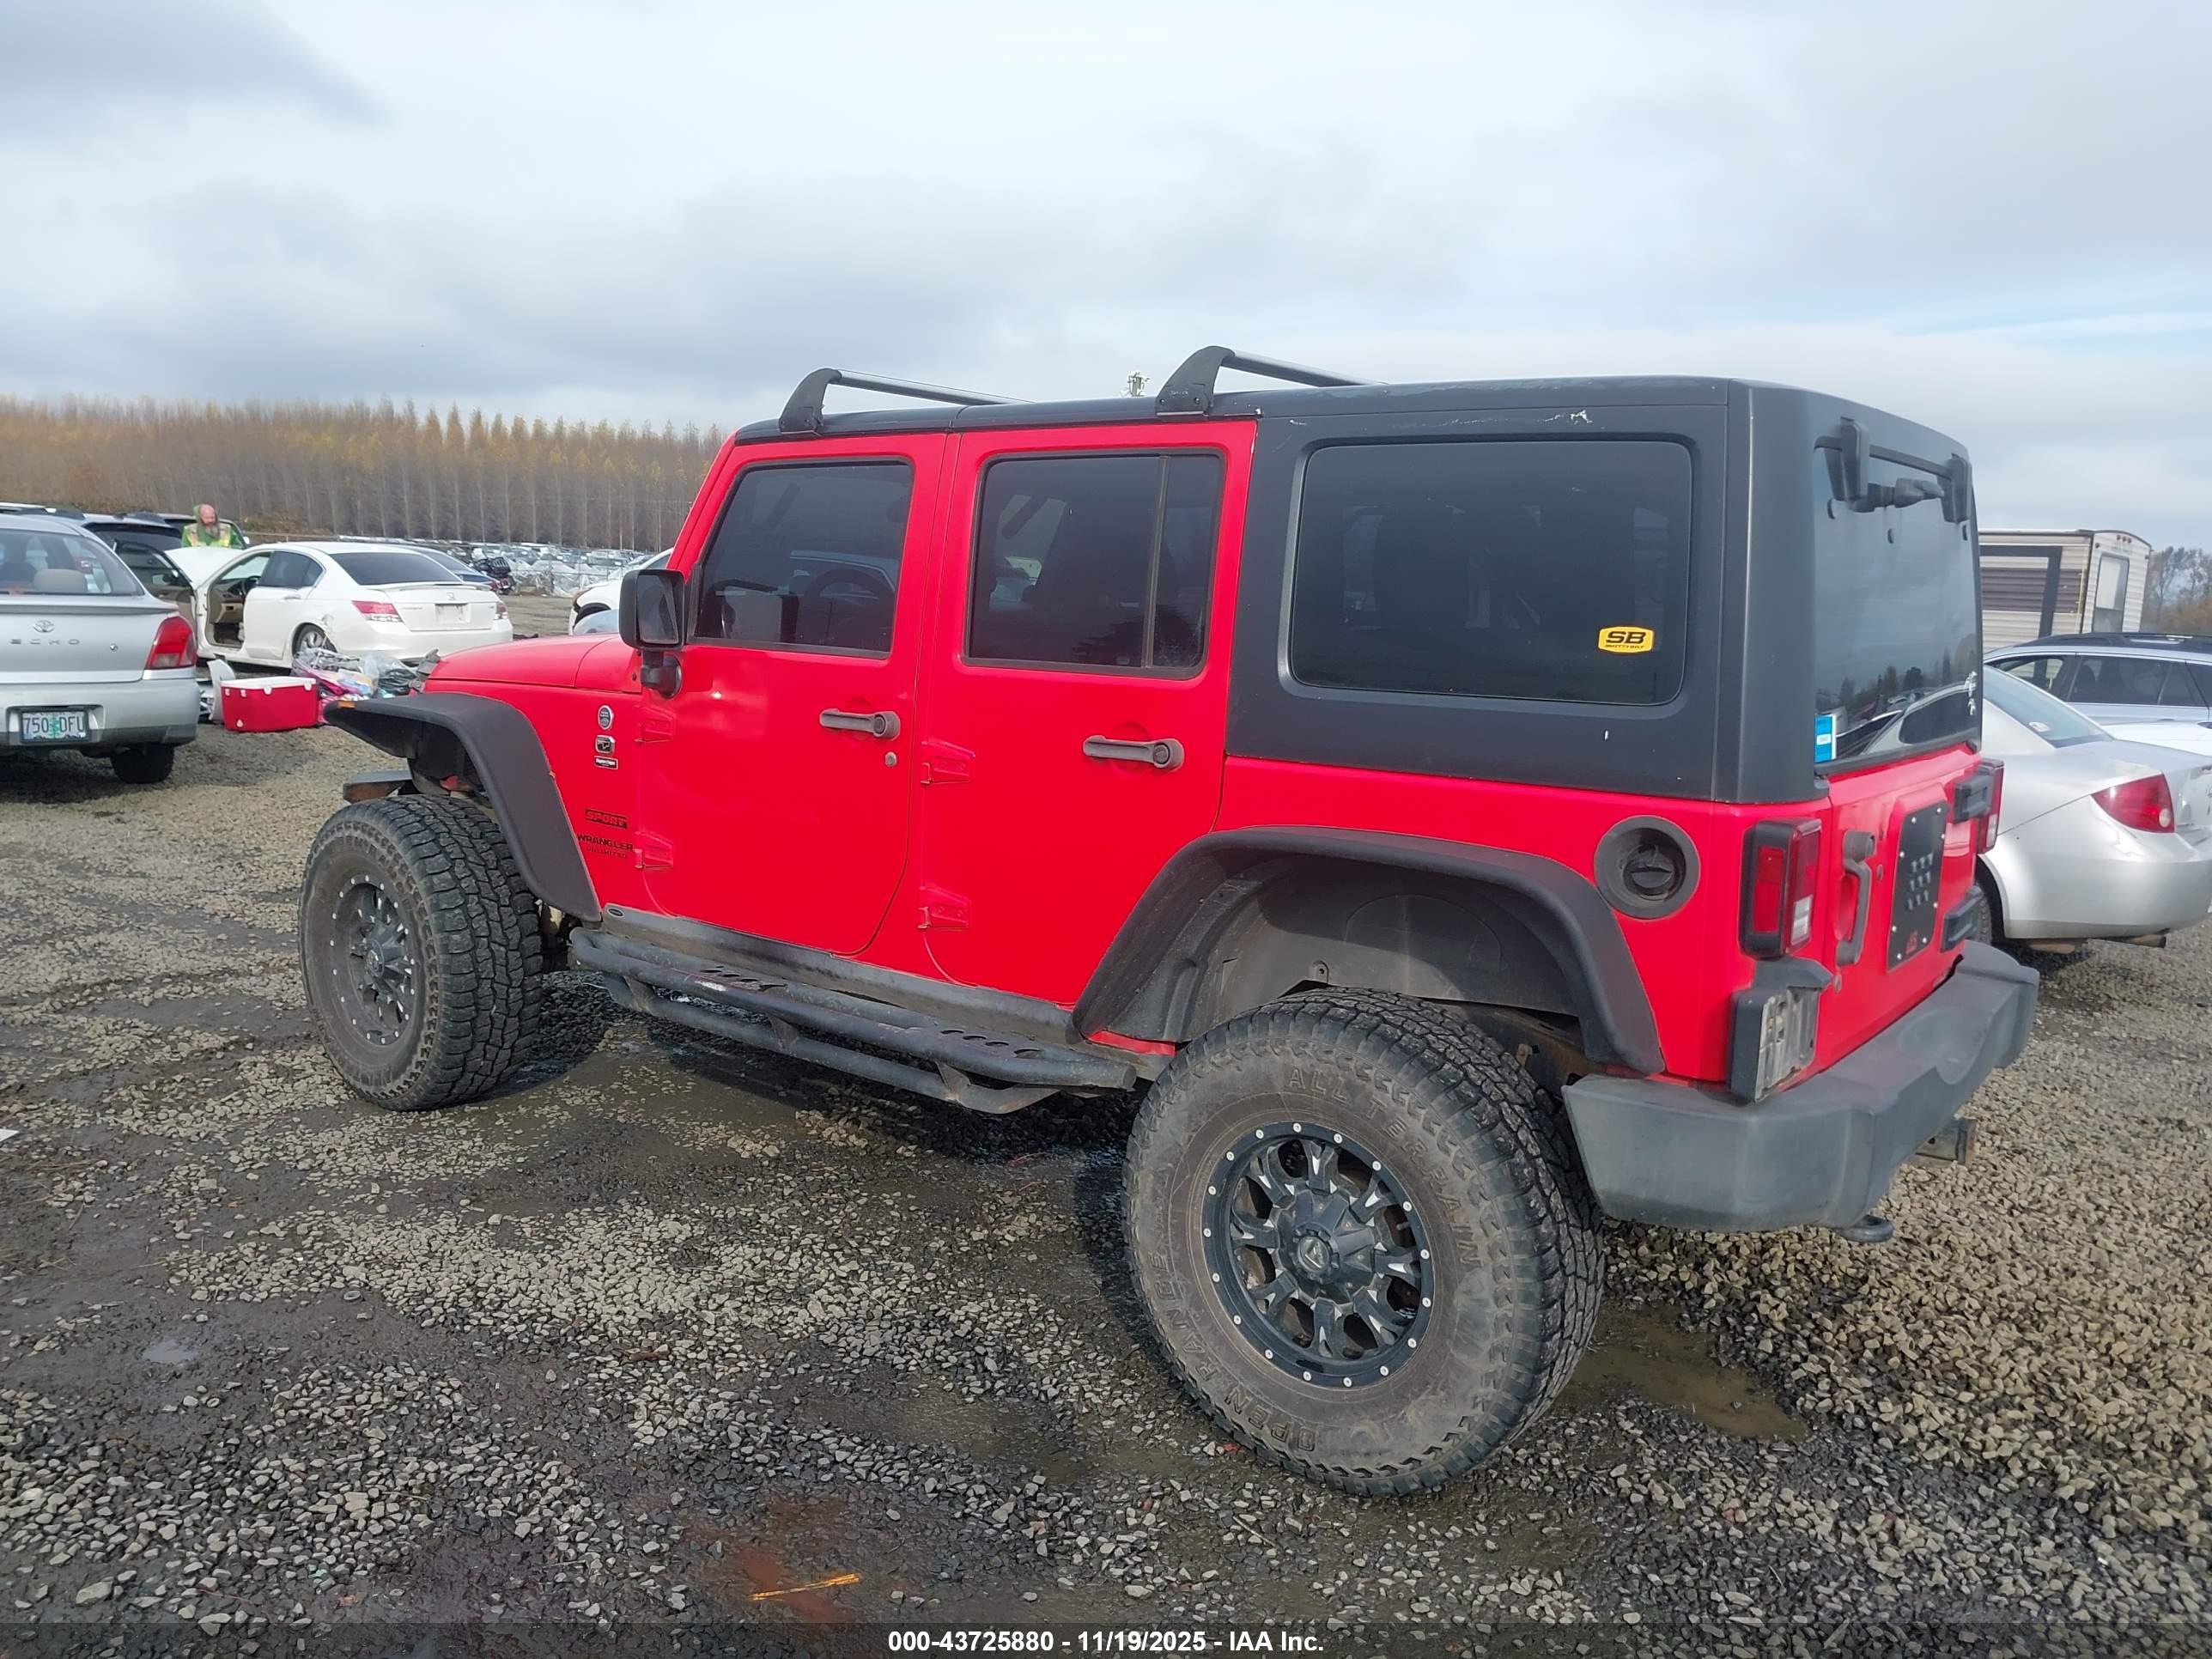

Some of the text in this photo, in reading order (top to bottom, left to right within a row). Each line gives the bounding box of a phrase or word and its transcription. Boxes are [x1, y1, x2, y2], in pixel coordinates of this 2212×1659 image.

[1606, 631, 1646, 644] SB
[23, 717, 49, 734] 750
[586, 811, 627, 826] SPORT
[577, 833, 635, 852] WRANGLER
[586, 845, 627, 858] UNLIMITED
[1288, 1066, 1347, 1106] ALL
[1224, 1385, 1317, 1452] OPEN
